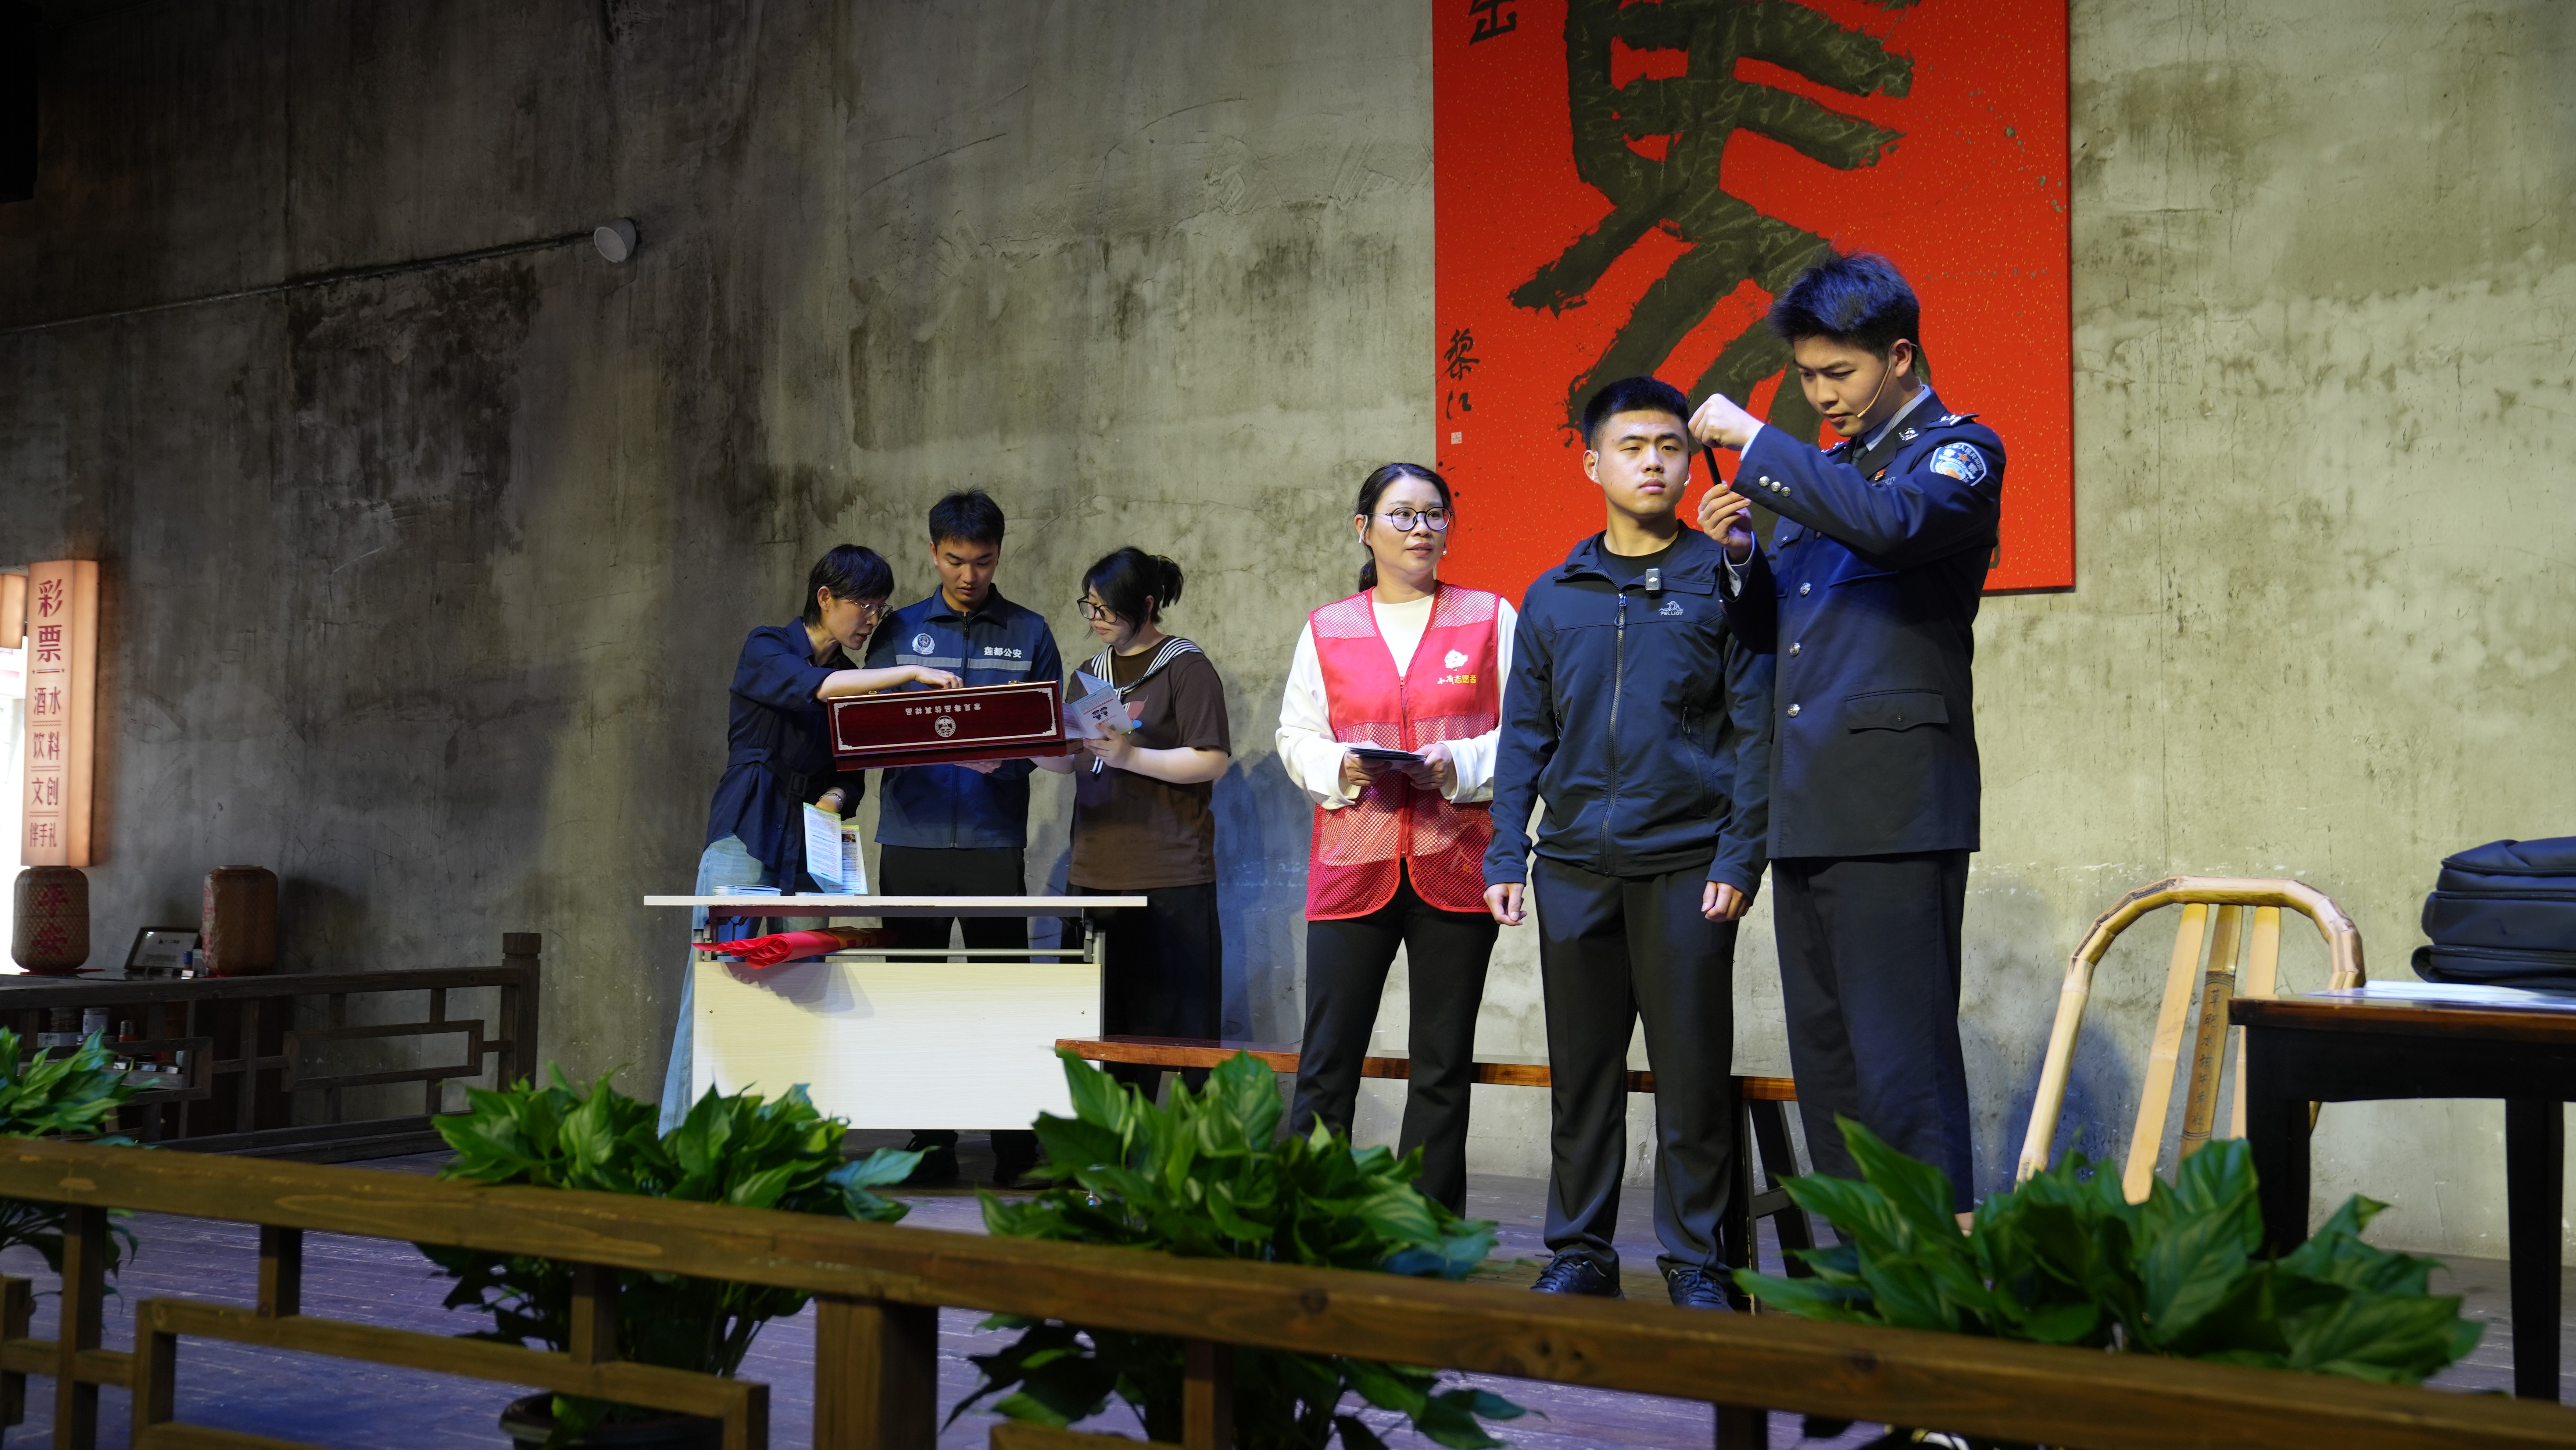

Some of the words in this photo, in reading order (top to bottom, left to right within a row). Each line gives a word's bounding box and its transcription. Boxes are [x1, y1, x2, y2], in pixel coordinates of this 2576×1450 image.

[37, 579, 62, 662] 彩票
[984, 646, 1022, 658] 莲都公安
[33, 686, 62, 716] 酒水
[905, 703, 981, 715] 常见毒品仿真样品
[33, 732, 60, 761] 饮料
[31, 776, 58, 807] 文创
[29, 822, 58, 847] 伴手礼
